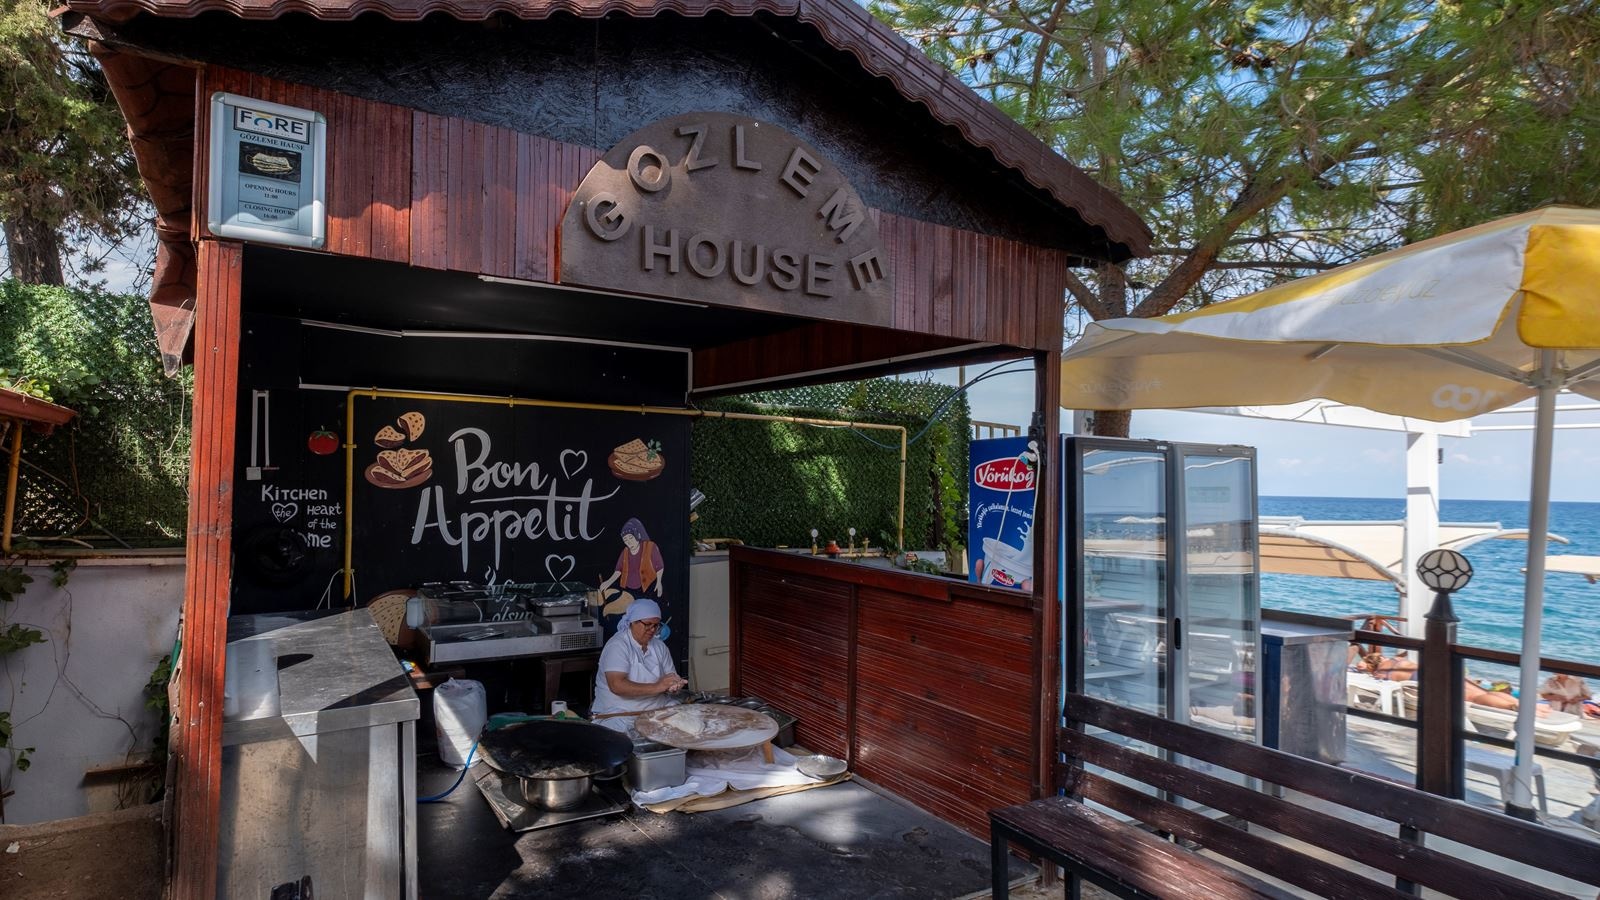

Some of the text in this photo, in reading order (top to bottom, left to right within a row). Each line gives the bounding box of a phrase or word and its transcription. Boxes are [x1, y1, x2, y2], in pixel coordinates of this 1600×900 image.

[240, 110, 303, 135] FORE
[244, 183, 297, 196] OPENING HOURS
[244, 204, 296, 216] CLOSING HOURS
[584, 123, 888, 291] GOZLEME
[641, 224, 834, 298] HOUSE
[448, 427, 548, 495] Bon
[275, 508, 291, 518] the
[307, 518, 337, 529] of the
[411, 478, 620, 573] Appetit
